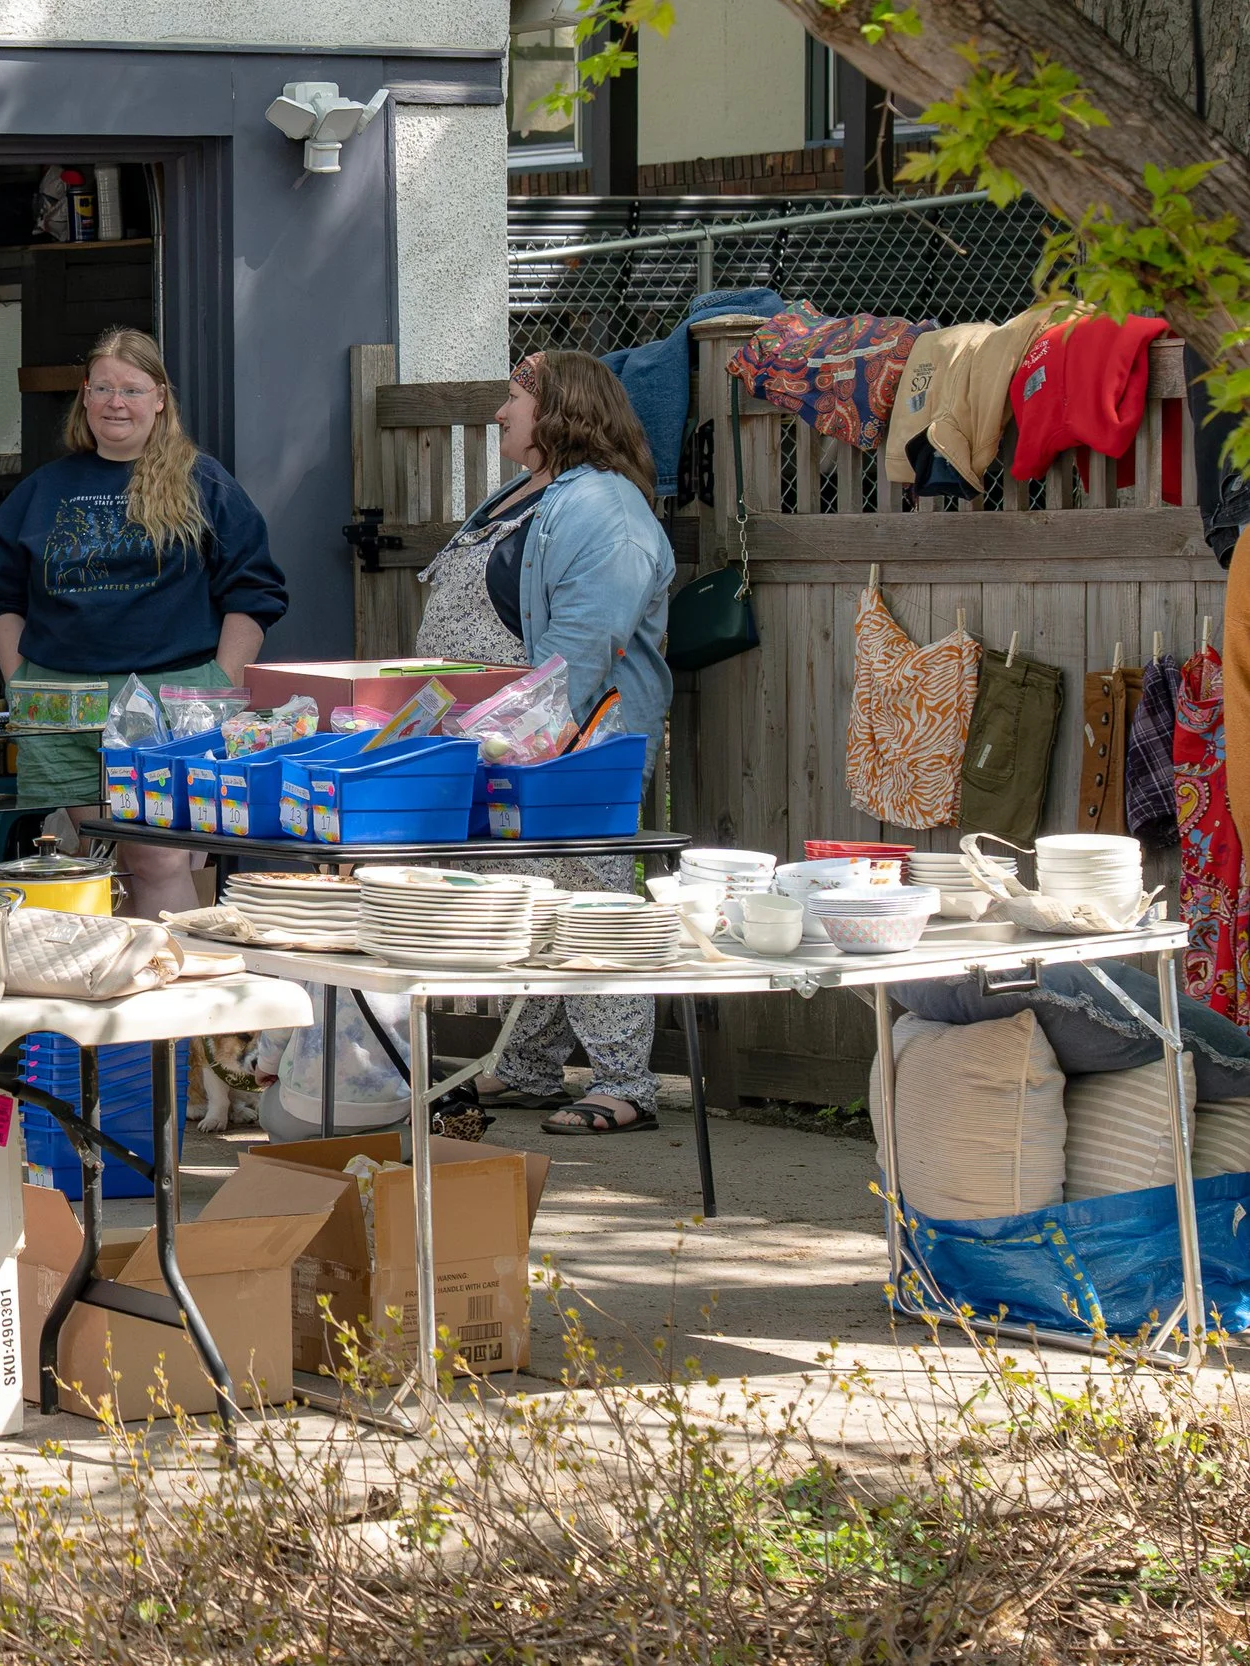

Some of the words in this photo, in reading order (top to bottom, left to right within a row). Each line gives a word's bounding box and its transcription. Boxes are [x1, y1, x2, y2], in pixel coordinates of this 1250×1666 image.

[119, 793, 131, 809] 18
[153, 801, 166, 817] 21
[198, 806, 208, 821] 14
[229, 807, 241, 824] 10
[289, 806, 302, 825] 13
[500, 811, 511, 828] 19
[321, 815, 331, 831] 17
[437, 1272, 469, 1282] WARNING:
[465, 1282, 481, 1291] WITH
[482, 1280, 500, 1289] CARE
[0, 1288, 16, 1386] SKU:490301
